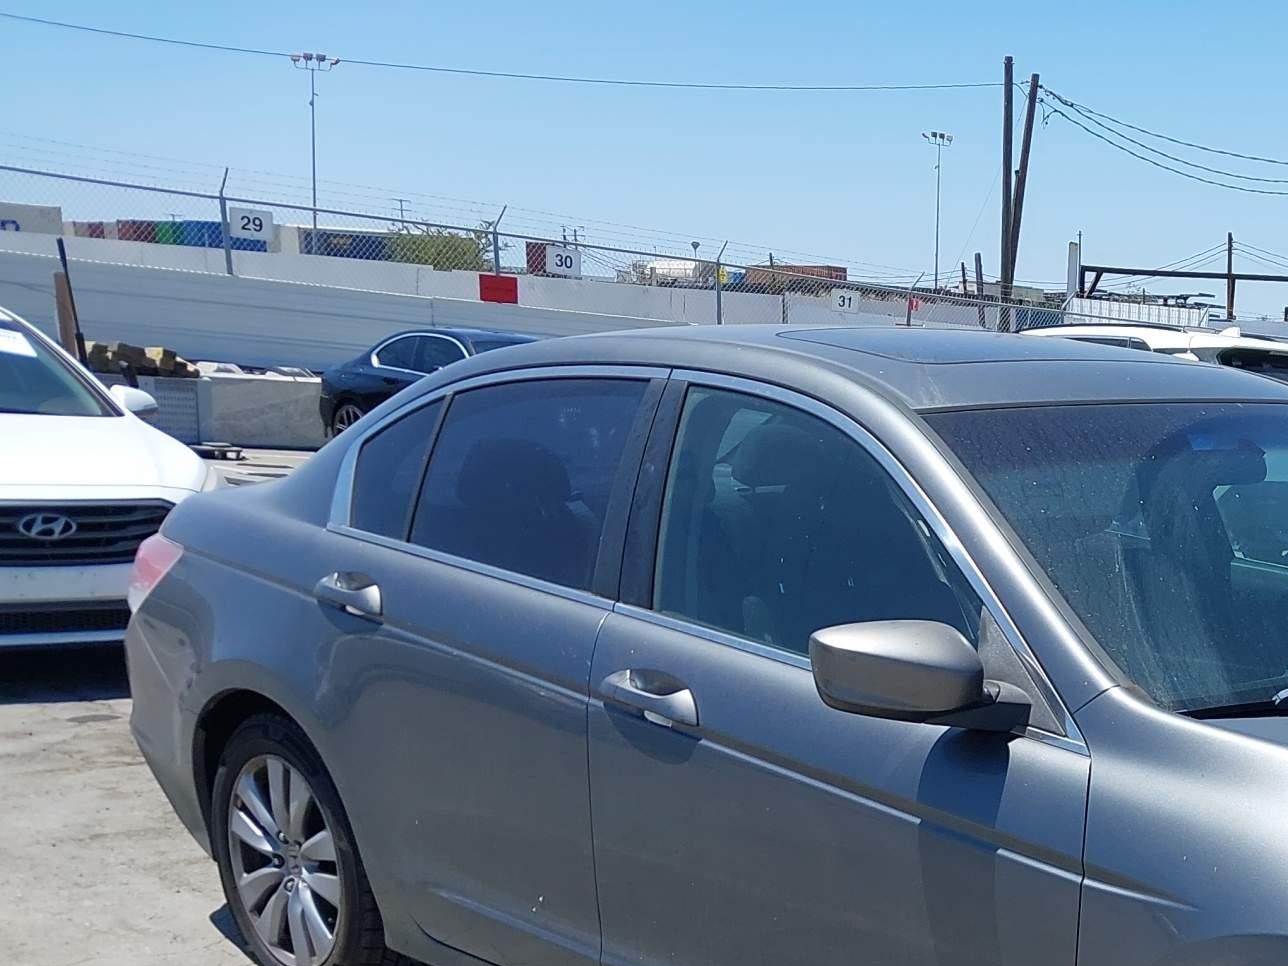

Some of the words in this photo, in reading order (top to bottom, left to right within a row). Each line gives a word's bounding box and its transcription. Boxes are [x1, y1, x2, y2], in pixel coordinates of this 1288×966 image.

[240, 215, 264, 233] 29
[554, 253, 573, 269] 30
[838, 295, 852, 309] 31
